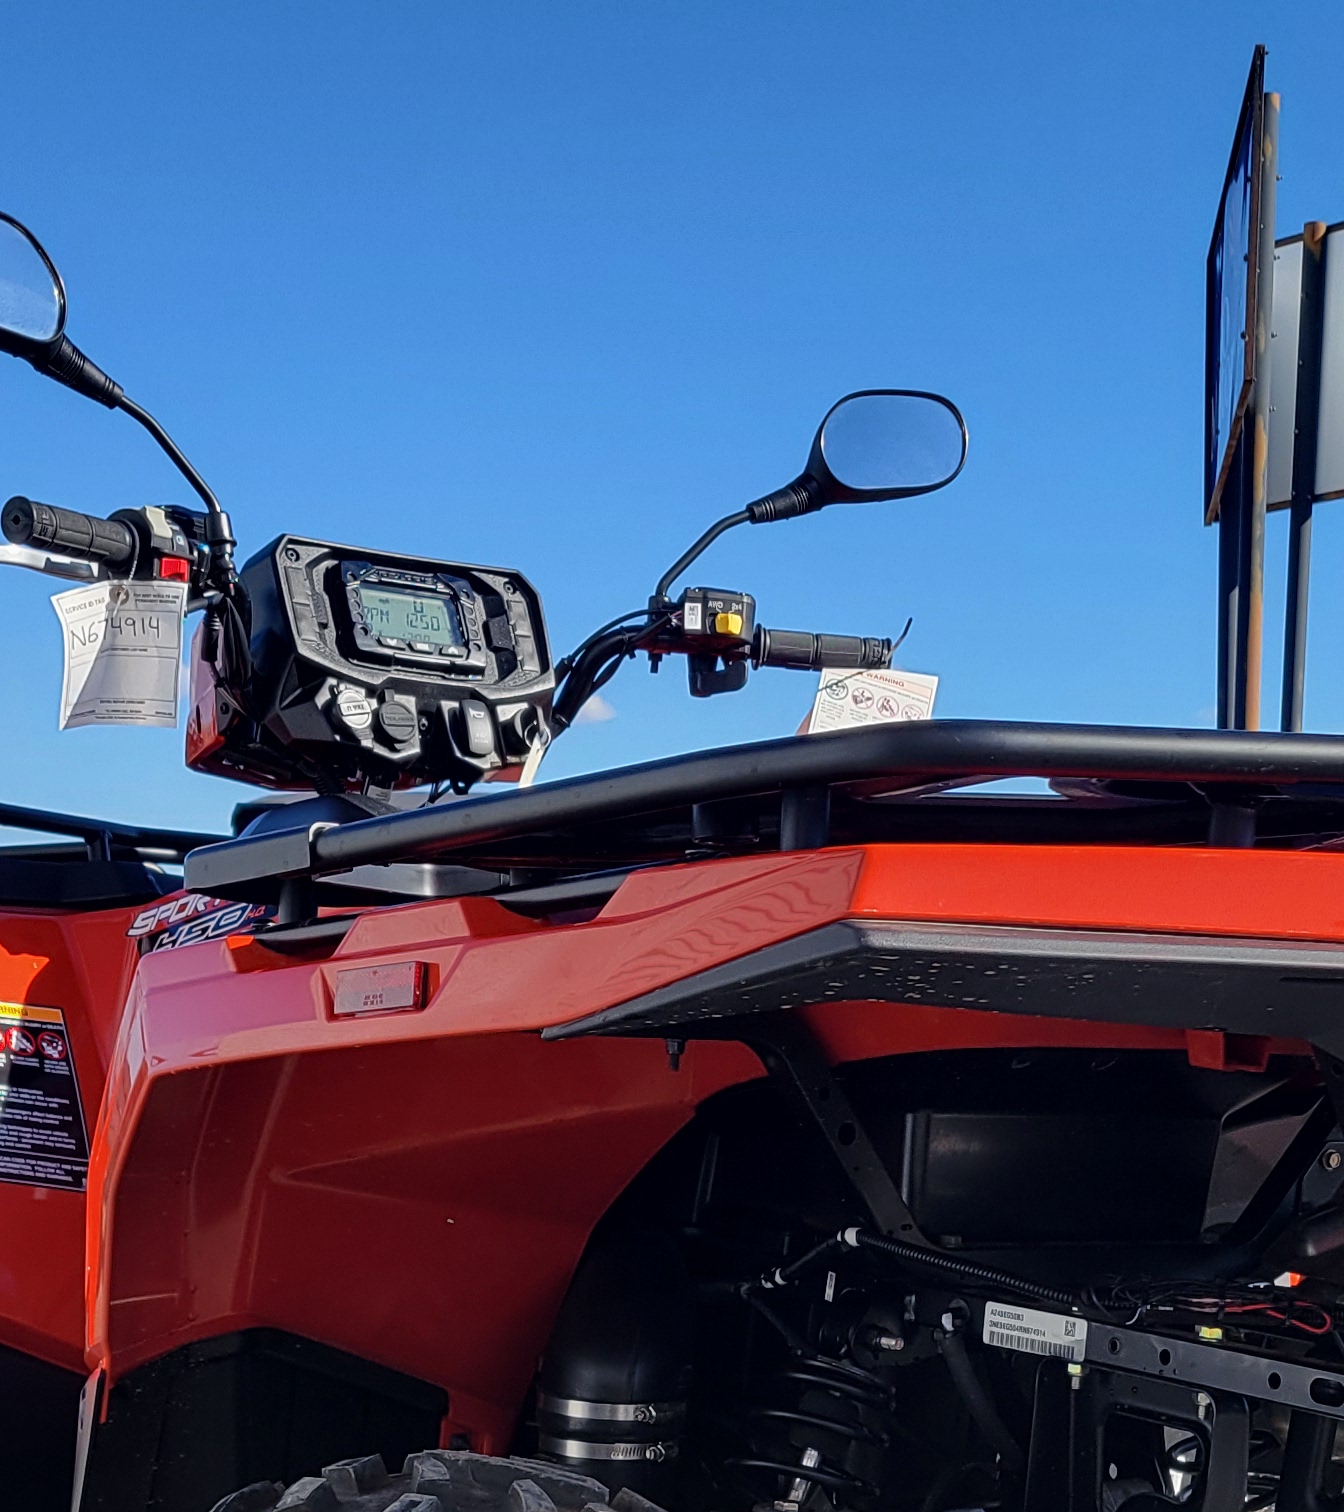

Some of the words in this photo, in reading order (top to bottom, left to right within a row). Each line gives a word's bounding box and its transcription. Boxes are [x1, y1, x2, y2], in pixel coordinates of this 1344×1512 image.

[64, 602, 88, 614] SERVICE
[406, 612, 440, 632] 1250
[70, 616, 160, 650] N674914
[866, 672, 905, 688] WARNING
